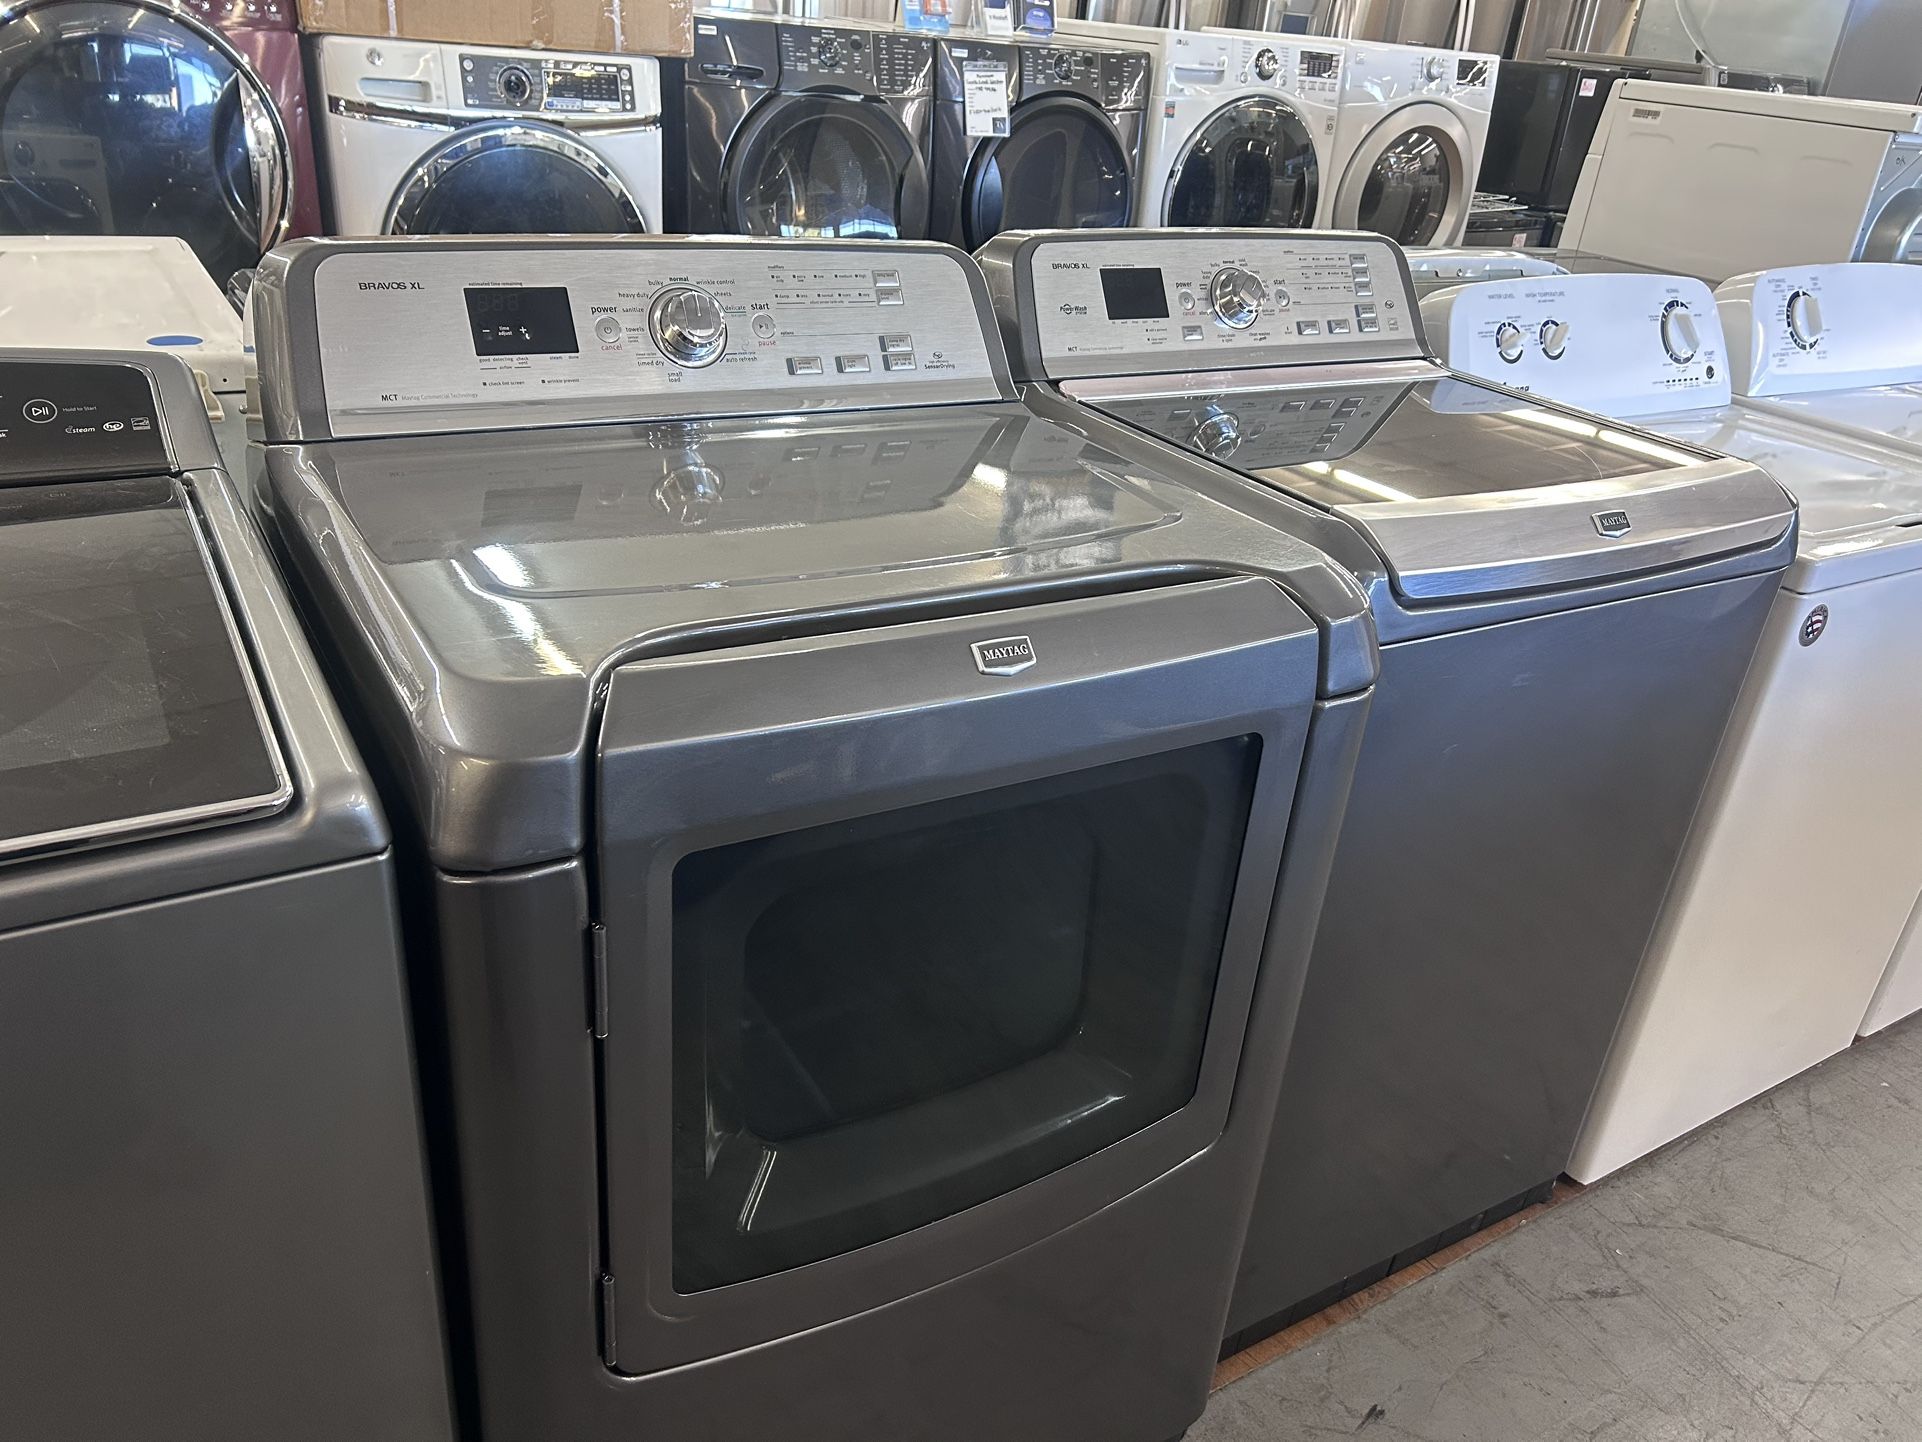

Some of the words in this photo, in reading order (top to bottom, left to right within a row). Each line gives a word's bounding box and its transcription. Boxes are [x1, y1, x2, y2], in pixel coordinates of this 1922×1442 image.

[359, 282, 408, 290] BRAVOS
[410, 282, 425, 290] XL
[1175, 282, 1192, 290] power
[591, 306, 617, 315] power
[750, 303, 770, 311] start
[601, 343, 623, 351] cancel
[1601, 516, 1627, 527] MAYTAG
[983, 644, 1029, 661] MAYTAG
